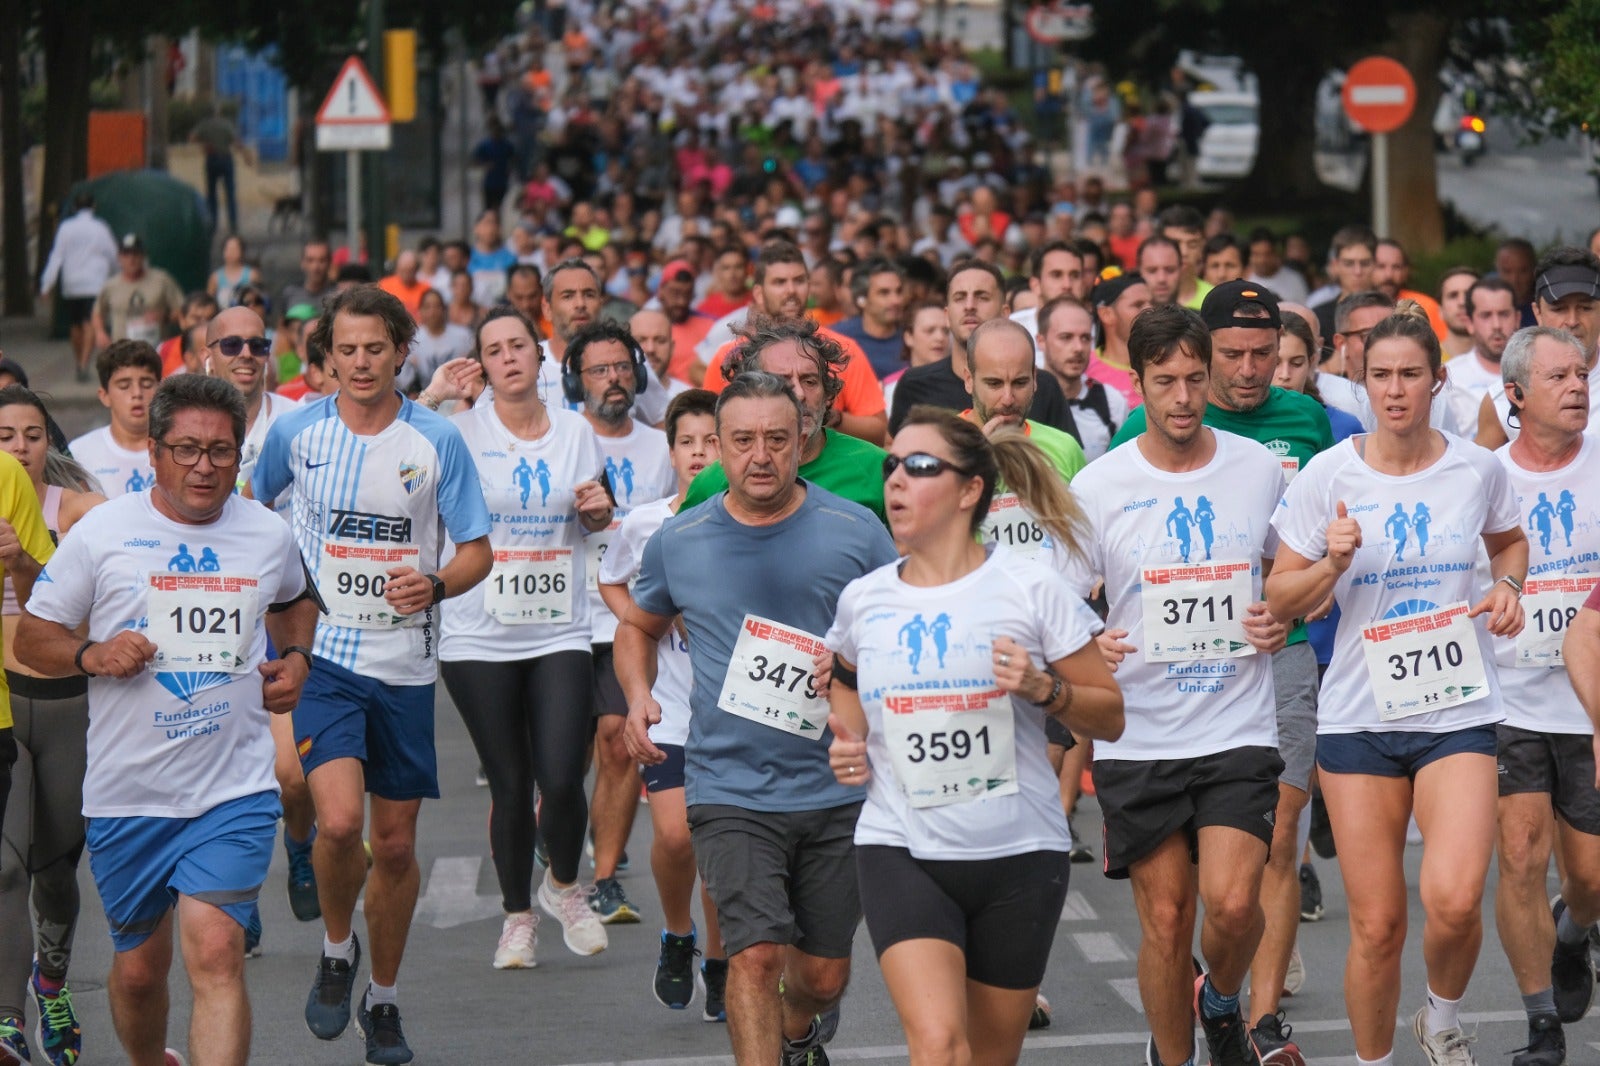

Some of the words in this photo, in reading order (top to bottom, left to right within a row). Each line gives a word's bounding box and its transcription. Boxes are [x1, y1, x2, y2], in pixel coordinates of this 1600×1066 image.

[1282, 461, 1298, 469] ANA
[329, 509, 412, 543] TESESA
[503, 514, 546, 524] CARRERA
[325, 543, 347, 559] 42
[348, 547, 386, 555] CARRERA
[1144, 569, 1171, 584] 42
[1170, 566, 1212, 576] CARRERA
[1214, 563, 1250, 573] URBANA
[1529, 556, 1576, 575] CARRERA
[151, 576, 177, 591] 42
[178, 576, 221, 586] CARRERA
[224, 577, 258, 587] URBANA
[337, 572, 386, 597] 990
[494, 573, 566, 595] 11036
[1196, 572, 1232, 582] MALAGA
[1364, 573, 1378, 585] 42
[1538, 579, 1574, 587] CARRERA
[1163, 595, 1233, 625] 3711
[170, 606, 241, 635] 1021
[1364, 624, 1391, 643] 42
[1390, 615, 1432, 631] CARRERA
[1434, 606, 1469, 621] URBANA
[1417, 618, 1452, 633] MALAGA
[745, 619, 772, 641] 42
[772, 627, 814, 646] CARRERA
[815, 641, 831, 653] UR
[1167, 662, 1236, 675] Fundación
[1388, 641, 1464, 681] 3710
[1177, 680, 1224, 694] Unicaja
[154, 700, 230, 722] Fundación
[886, 696, 914, 714] 42
[914, 694, 963, 704] CARRERA
[966, 689, 1007, 701] URBANA
[166, 720, 220, 740] Unicaja
[907, 725, 991, 763] 3591
